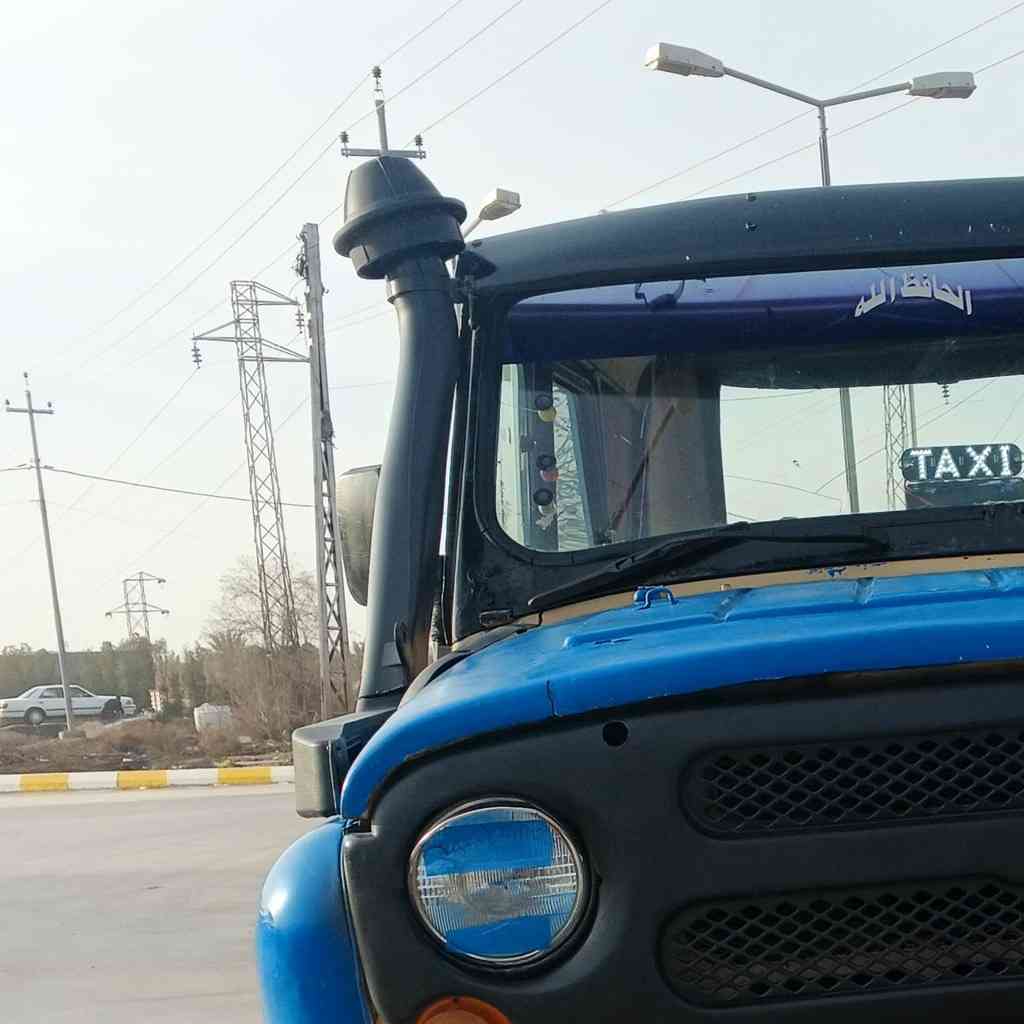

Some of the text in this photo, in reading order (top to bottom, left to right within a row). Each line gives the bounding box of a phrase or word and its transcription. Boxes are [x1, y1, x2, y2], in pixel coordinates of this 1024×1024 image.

[854, 271, 972, 317] الحافظ الله
[910, 445, 1012, 480] TAXI
